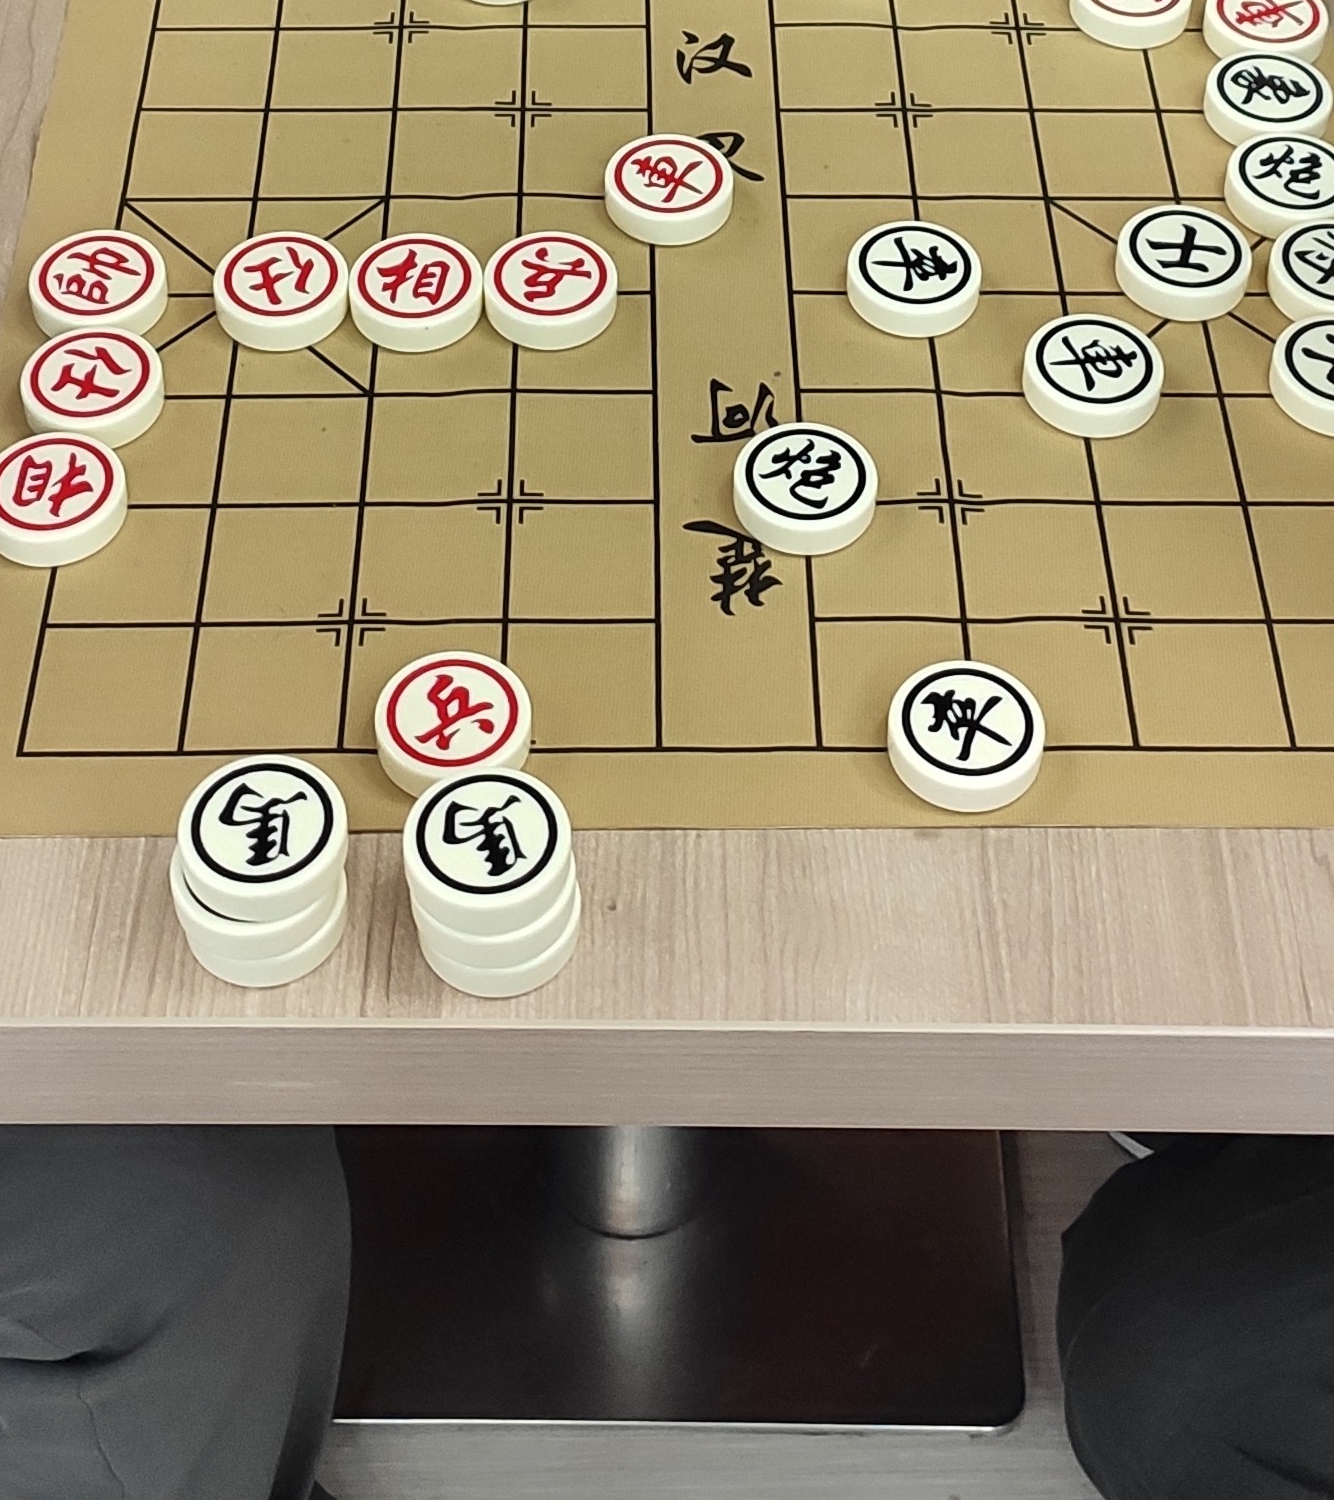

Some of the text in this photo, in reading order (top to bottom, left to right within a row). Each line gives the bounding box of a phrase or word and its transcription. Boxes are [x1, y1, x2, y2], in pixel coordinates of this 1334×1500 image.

[1231, 66, 1310, 104] 象
[522, 248, 591, 302] 兵
[1146, 224, 1227, 272] 士
[243, 247, 314, 305] 仕
[377, 249, 450, 305] 相
[51, 347, 131, 400] 仕
[12, 453, 93, 517] 相
[415, 674, 494, 750] 兵
